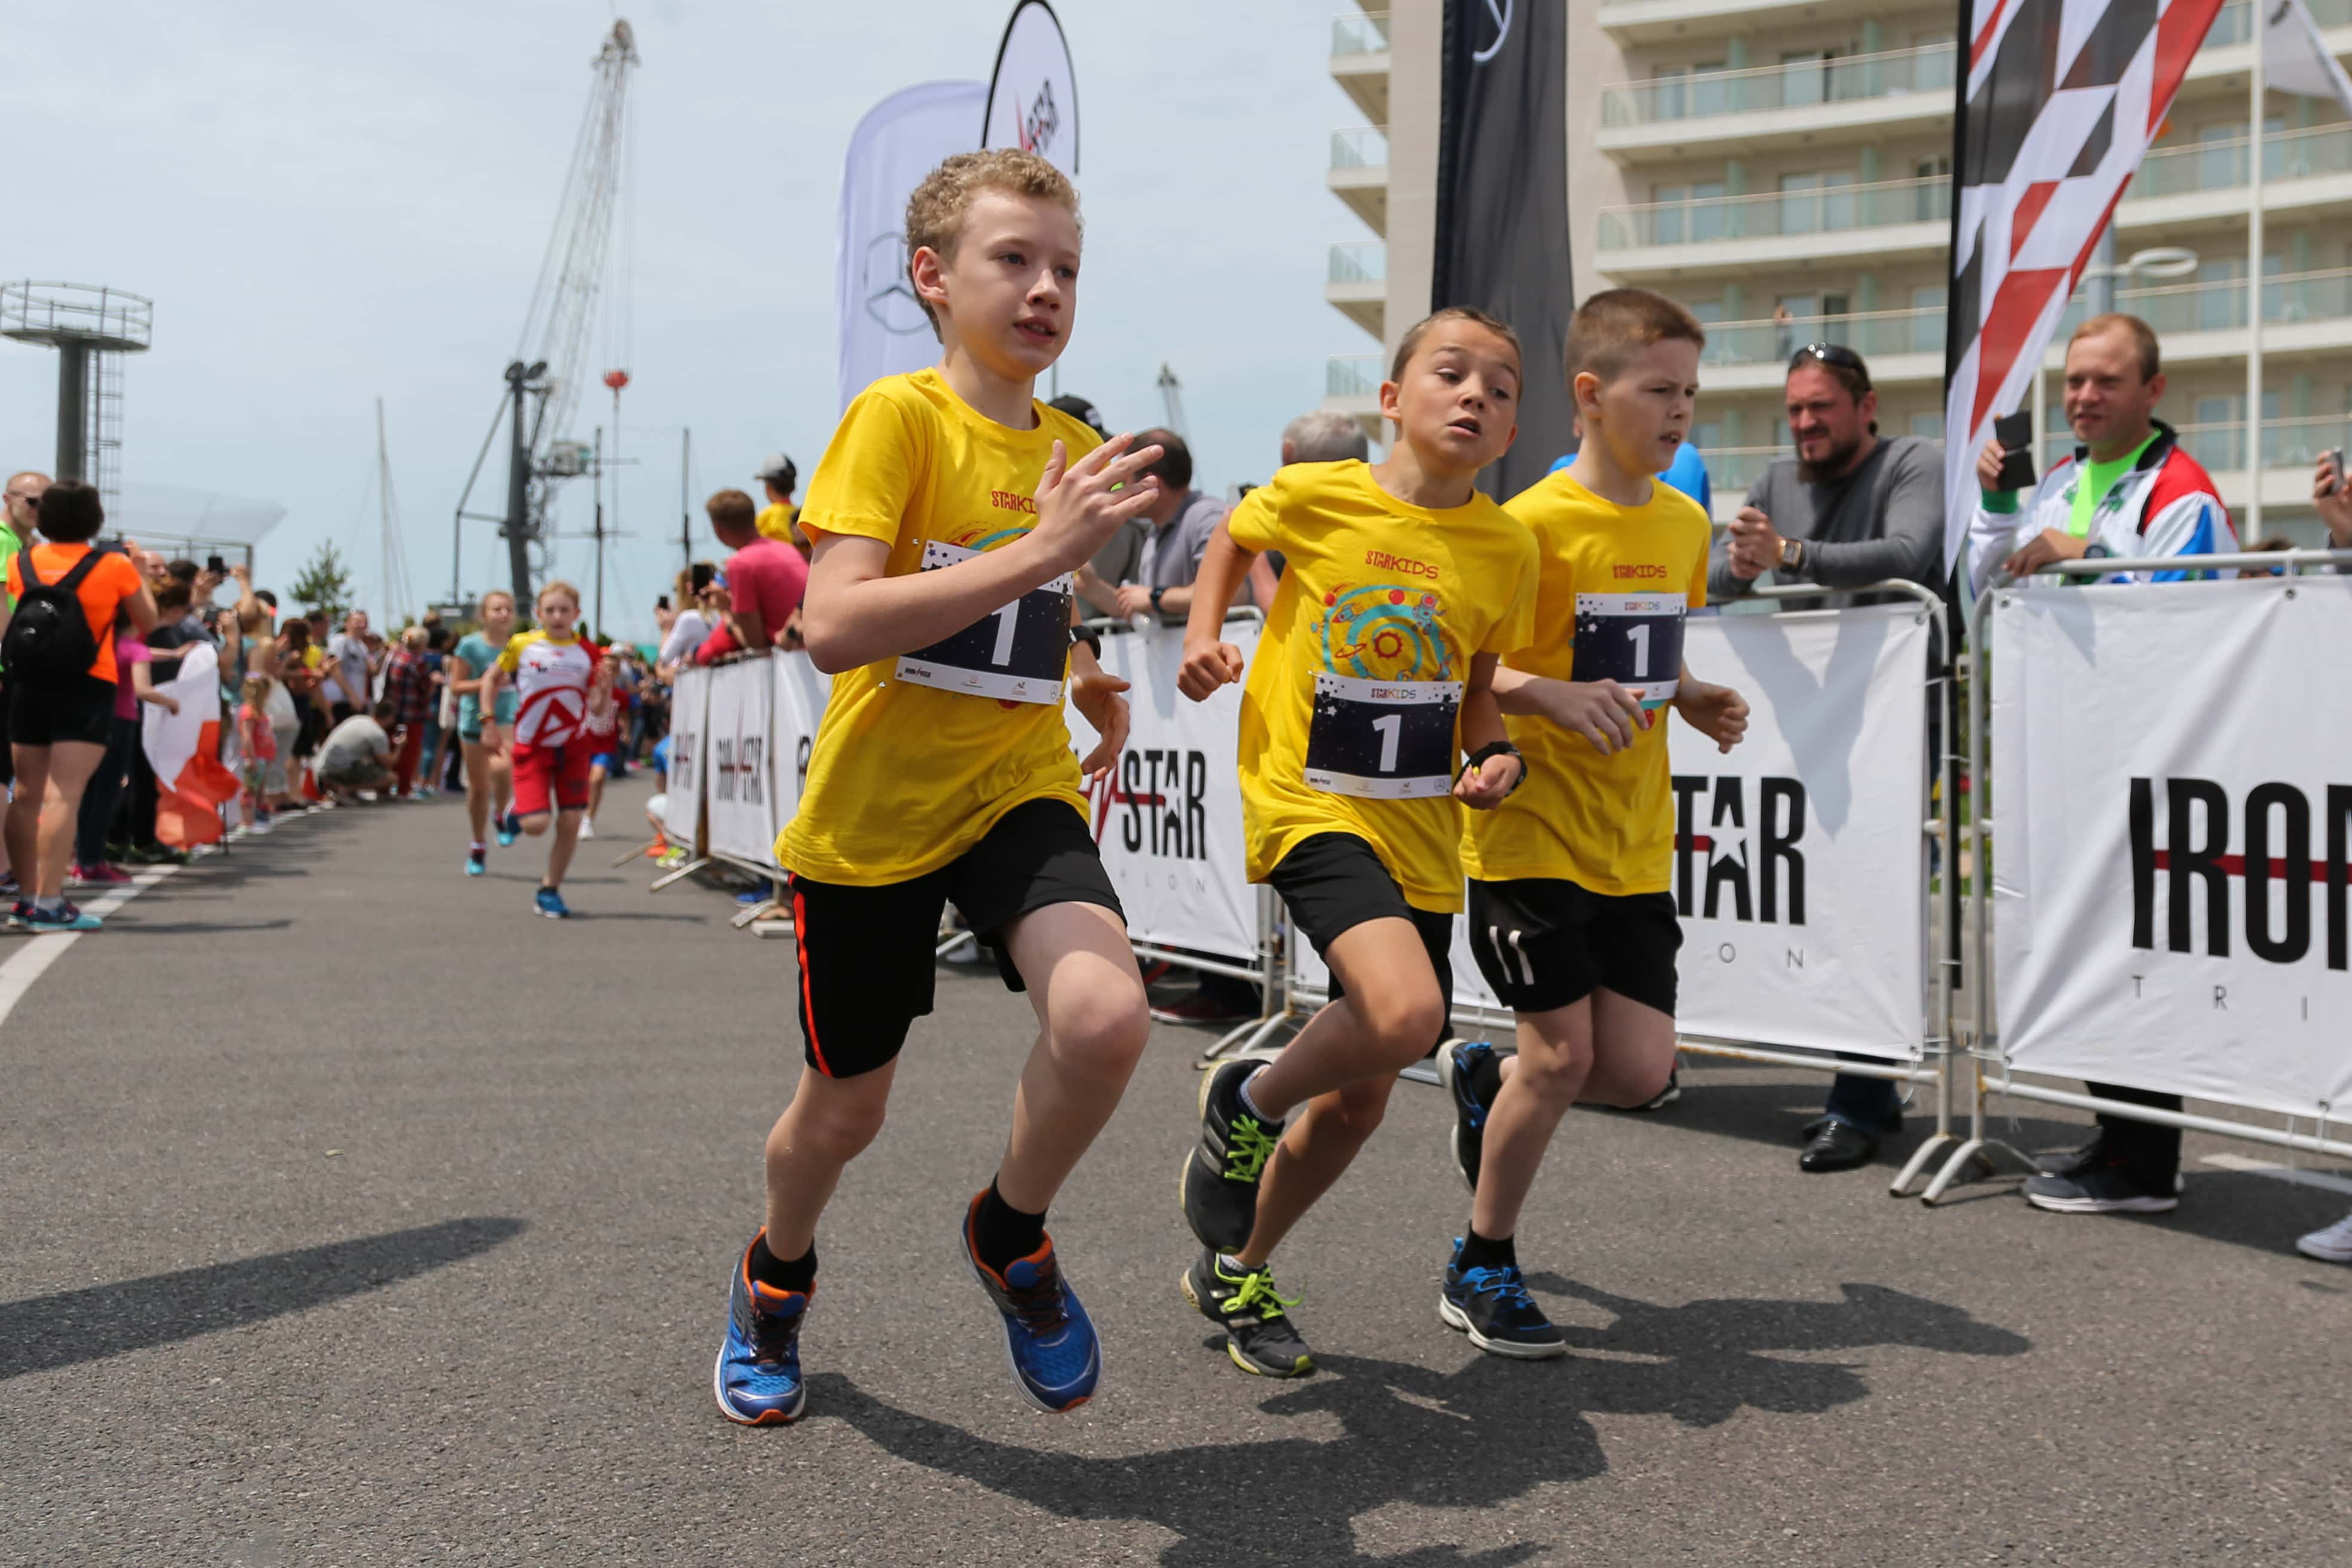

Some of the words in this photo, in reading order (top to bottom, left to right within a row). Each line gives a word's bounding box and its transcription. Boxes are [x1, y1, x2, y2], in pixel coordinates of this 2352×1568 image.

[992, 490, 1037, 514] STARKI
[1366, 550, 1439, 579] STARKIDS
[991, 598, 1020, 666] 1
[1626, 624, 1650, 677] 1
[1372, 714, 1402, 772] 1
[1123, 750, 1206, 860] STAR
[1671, 775, 1807, 925] TAR
